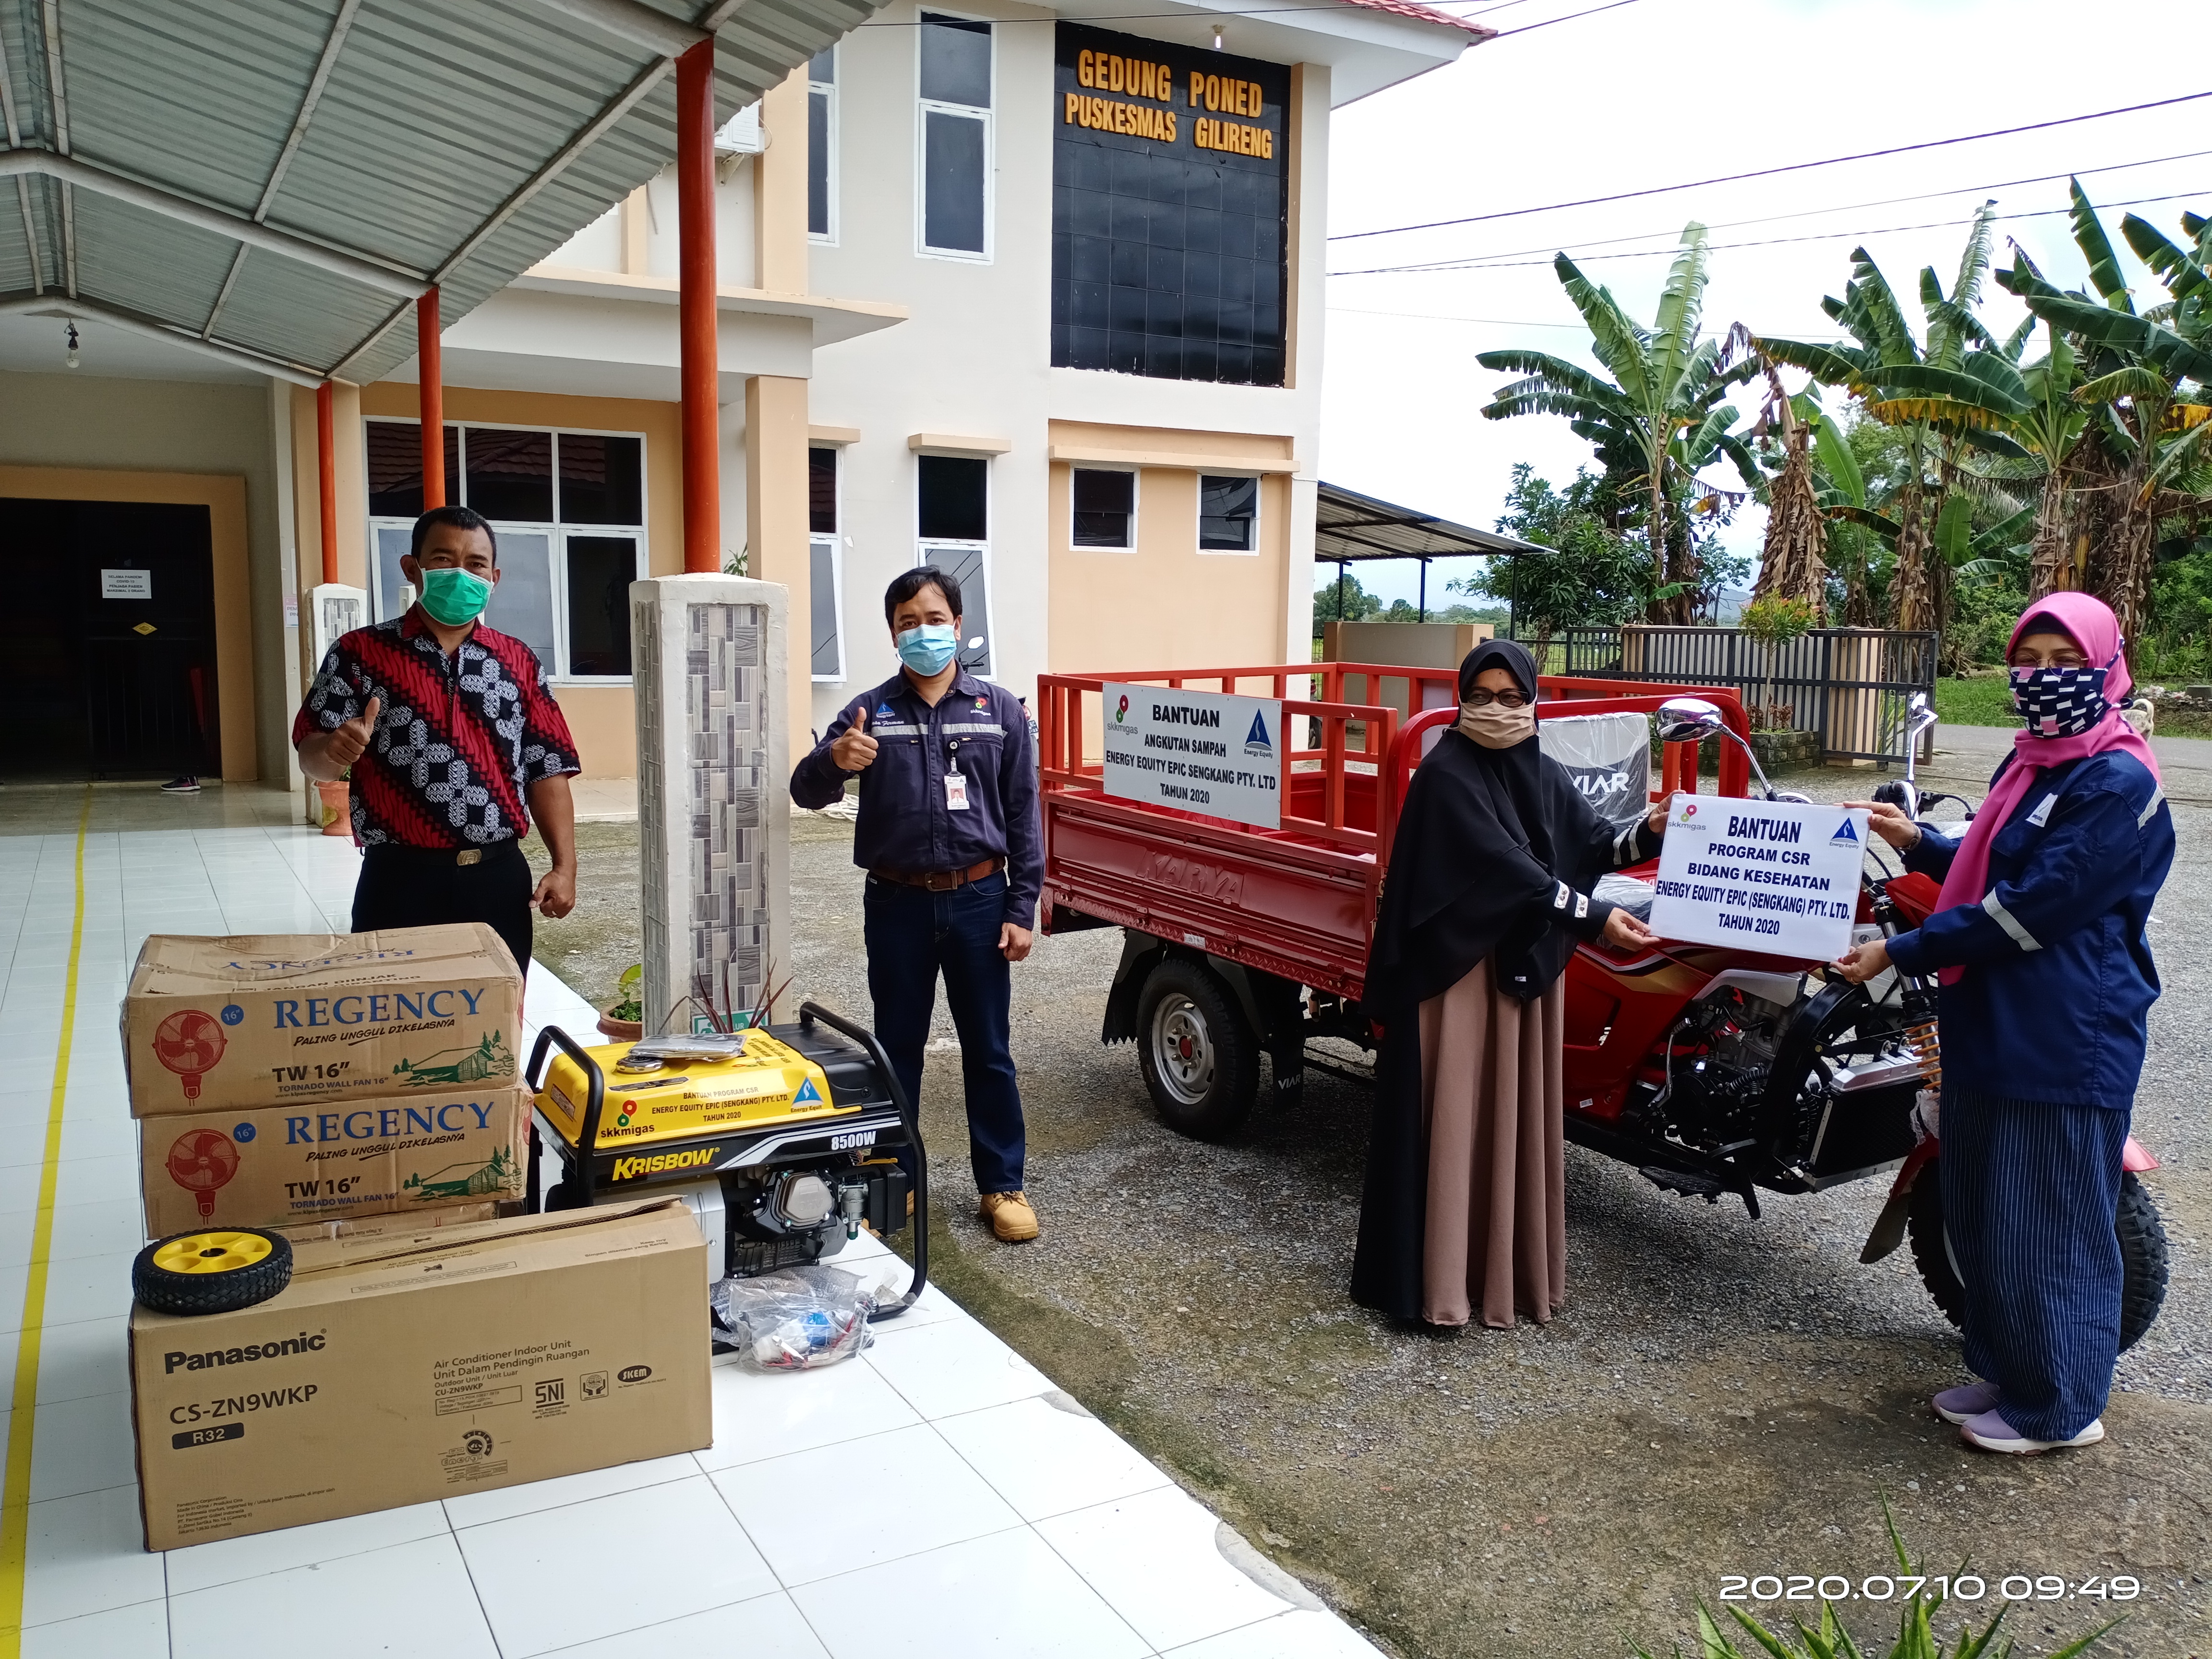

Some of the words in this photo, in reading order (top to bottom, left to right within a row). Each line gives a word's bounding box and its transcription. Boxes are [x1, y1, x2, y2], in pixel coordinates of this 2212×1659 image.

[1078, 49, 1171, 102] GEDUNG
[1188, 71, 1263, 118] PONED
[1064, 92, 1177, 143] PUSKESMAS
[1194, 116, 1273, 159] GILIRENG
[1153, 704, 1220, 728] BANTUAN
[1107, 721, 1139, 735] skkmigas
[1144, 733, 1190, 752] ANGKUTAN
[1192, 740, 1226, 757] SAMPAH
[1244, 748, 1259, 757] Energy
[1259, 750, 1273, 759] Equity
[1106, 750, 1135, 767] ENERGY
[1137, 755, 1166, 773] EQUITY
[1168, 761, 1186, 777] EPIC
[1188, 765, 1234, 784] SENGKANG
[1237, 773, 1256, 787] PTY.
[1258, 775, 1276, 790] LTD
[1160, 782, 1188, 800] TAHUN
[1190, 789, 1210, 804] 2020
[1667, 821, 1706, 831] skkmigas
[1727, 816, 1802, 843] BANTUAN
[1708, 842, 1778, 862] PROGRAM
[1781, 850, 1810, 866] CSR
[1135, 851, 1245, 904] KARYA
[1687, 863, 1740, 880] BIDANG
[1743, 868, 1830, 891] KESEHATAN
[1656, 880, 1691, 899] ENERGY
[1692, 885, 1726, 904] EQUITY
[1727, 889, 1748, 906] EPIC
[1749, 891, 1806, 918] (SENGKANG)
[1807, 899, 1827, 916] PTY.
[1829, 902, 1850, 920] LTD.
[1719, 913, 1754, 932] TAHUN
[1755, 920, 1780, 935] 2020
[273, 988, 485, 1030] REGENCY
[293, 1034, 337, 1046] PALING
[340, 1028, 385, 1045] UNGGUL
[388, 1019, 455, 1035] DIKELASNYA
[272, 1065, 308, 1082] TW
[314, 1061, 350, 1079] 16"
[1278, 1074, 1301, 1090] VIAR
[278, 1082, 325, 1092] TORNADO
[684, 1091, 712, 1100] BANTUAN
[713, 1088, 745, 1097] PROGRAM
[652, 1105, 678, 1114] ENERGY
[680, 1103, 704, 1112] EQUITY
[705, 1101, 721, 1110] EPIC
[721, 1098, 760, 1110] (SENGKANG)
[762, 1095, 775, 1104] PTY.
[776, 1094, 790, 1103] LTD.
[284, 1101, 495, 1145] REGENCY
[703, 1114, 726, 1122] TAHUN
[726, 1111, 742, 1120] 2020
[601, 1125, 655, 1138] skkmigas
[831, 1131, 876, 1151] 8500W
[305, 1149, 348, 1162] PALING
[350, 1142, 397, 1159] UNGGUL
[398, 1132, 465, 1150] DIKELASNYA
[612, 1148, 715, 1181] KRISBOW
[285, 1180, 320, 1199] TW
[325, 1176, 361, 1194] 16"
[290, 1199, 336, 1209] TORNADO
[337, 1196, 362, 1205] WALL
[364, 1193, 382, 1202] FAN
[165, 1332, 326, 1374] Panasonic
[434, 1360, 449, 1369] Air
[452, 1350, 512, 1366] Conditioner
[515, 1345, 548, 1357] Indoor
[551, 1340, 571, 1350] Unit
[434, 1370, 456, 1380] Unit
[458, 1364, 491, 1376] Dalam
[493, 1356, 543, 1370] Pendingin
[546, 1348, 589, 1362] Ruangan
[434, 1379, 464, 1388] Outdoor
[487, 1372, 502, 1380] Unit
[435, 1383, 483, 1396] CU-ZN9WKP
[169, 1384, 318, 1424] CS-ZN9WKP
[535, 1382, 564, 1404] SNI
[192, 1428, 225, 1444] R32
